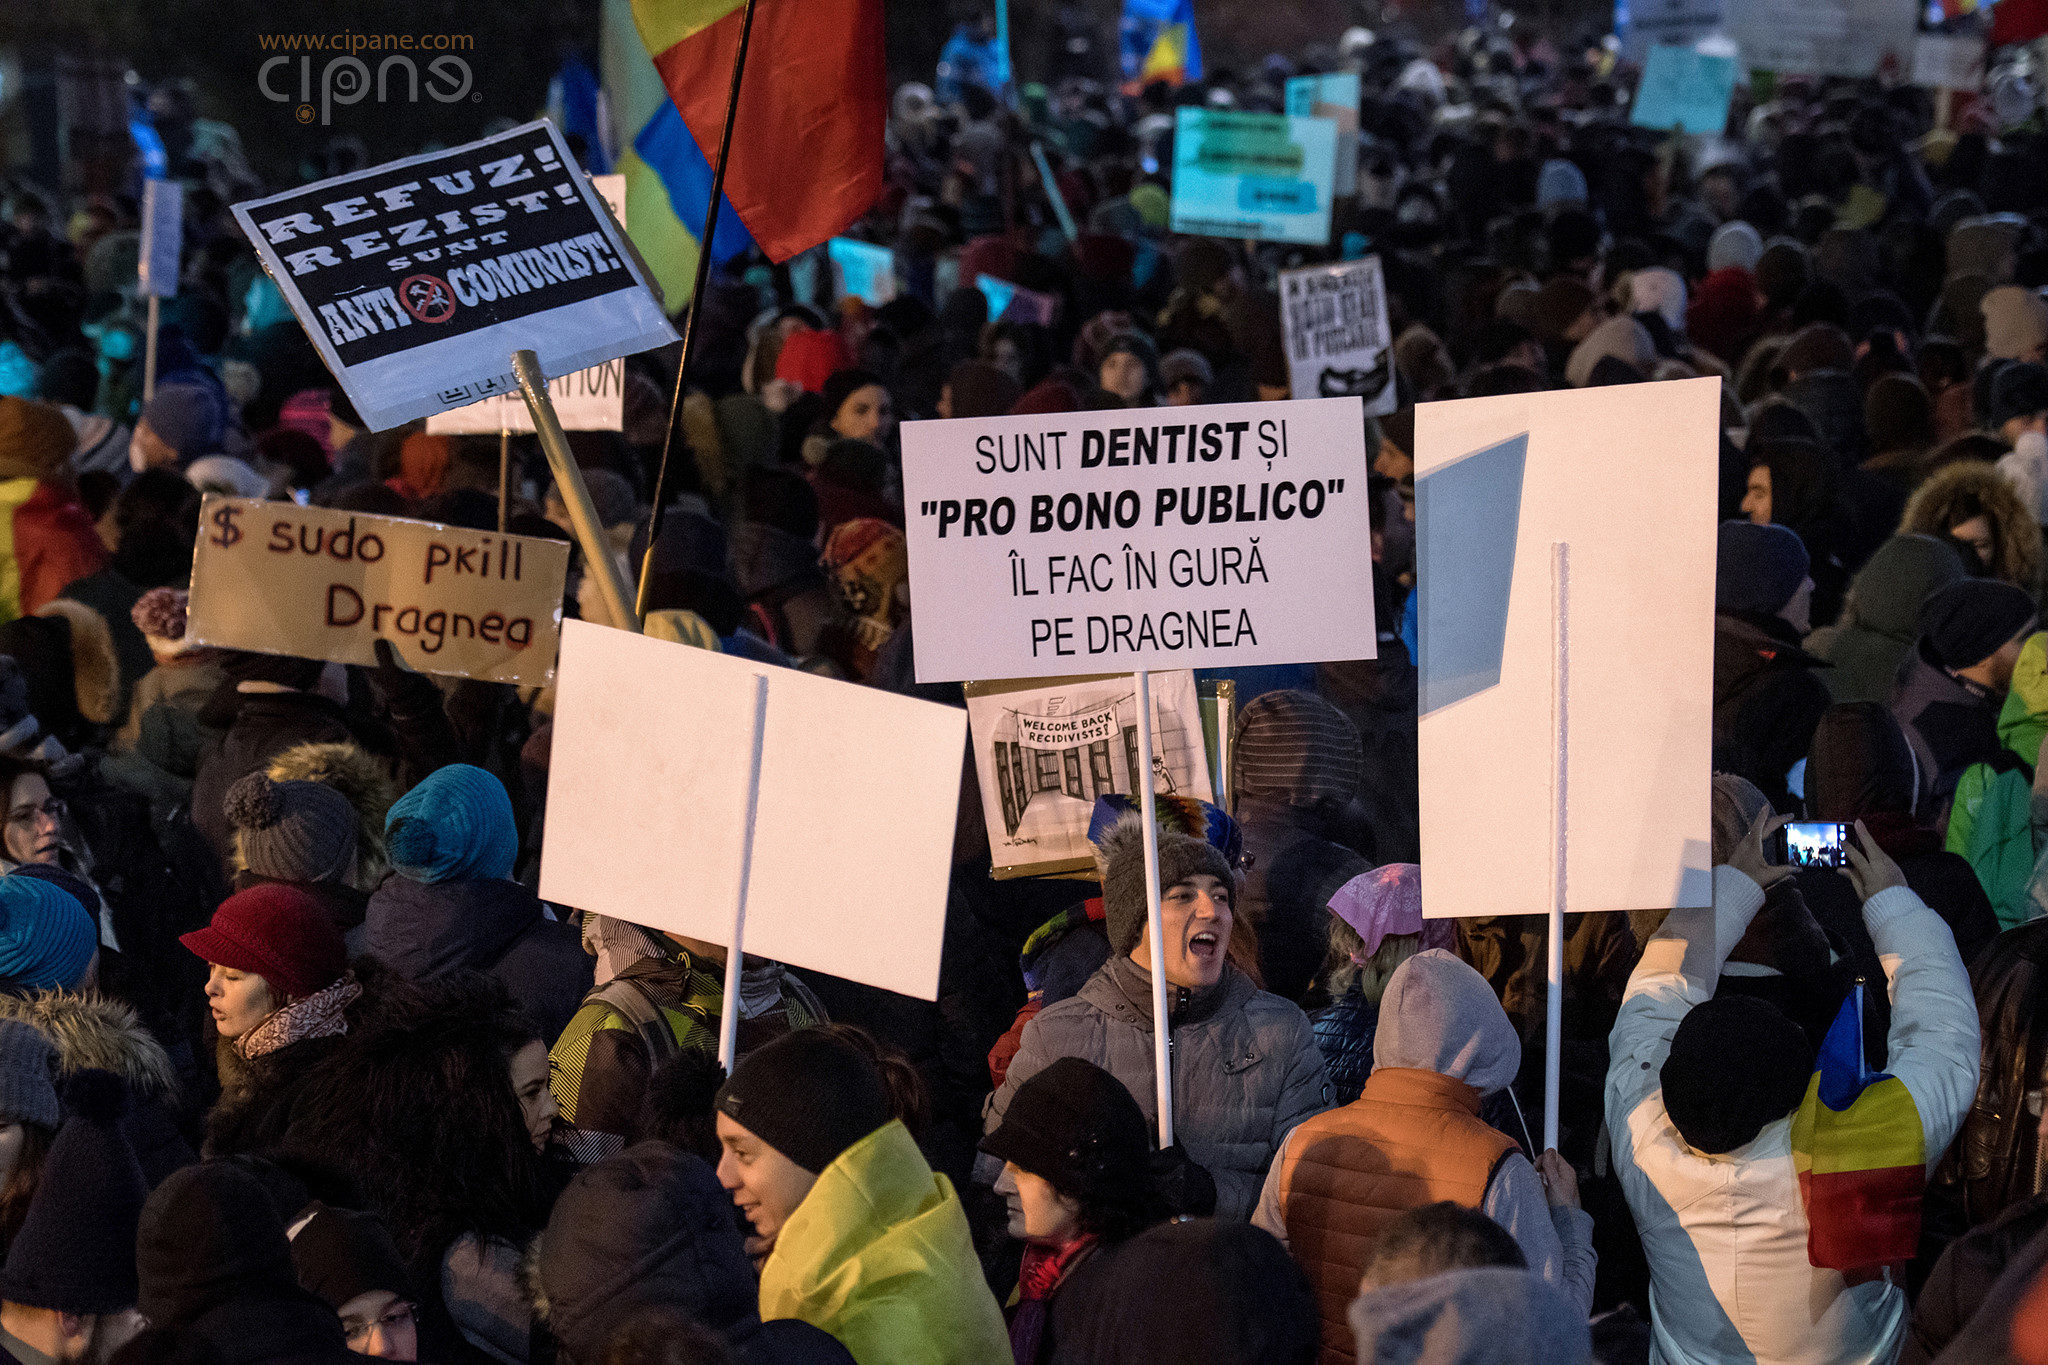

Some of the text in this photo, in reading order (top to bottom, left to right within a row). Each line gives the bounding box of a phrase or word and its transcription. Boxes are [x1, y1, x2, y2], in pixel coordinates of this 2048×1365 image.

[259, 144, 562, 245] REFUZ!
[284, 182, 580, 277] REZIST!
[386, 230, 509, 271] SUNT
[317, 231, 622, 346] ANTI COMUNIST!
[976, 419, 1288, 474] SUNT DENTIST ȘI
[920, 479, 1345, 538] "PRO BONO PUBLICO"
[210, 505, 522, 584] $ sudo pkill
[1008, 536, 1269, 596] ÎL FAC ÎN GURĂ
[325, 583, 534, 653] Dragnea
[1031, 608, 1258, 657] PE DRAGNEA
[1023, 711, 1112, 732] WELCOME BACK
[1029, 723, 1109, 743] RECIDIVISTS!
